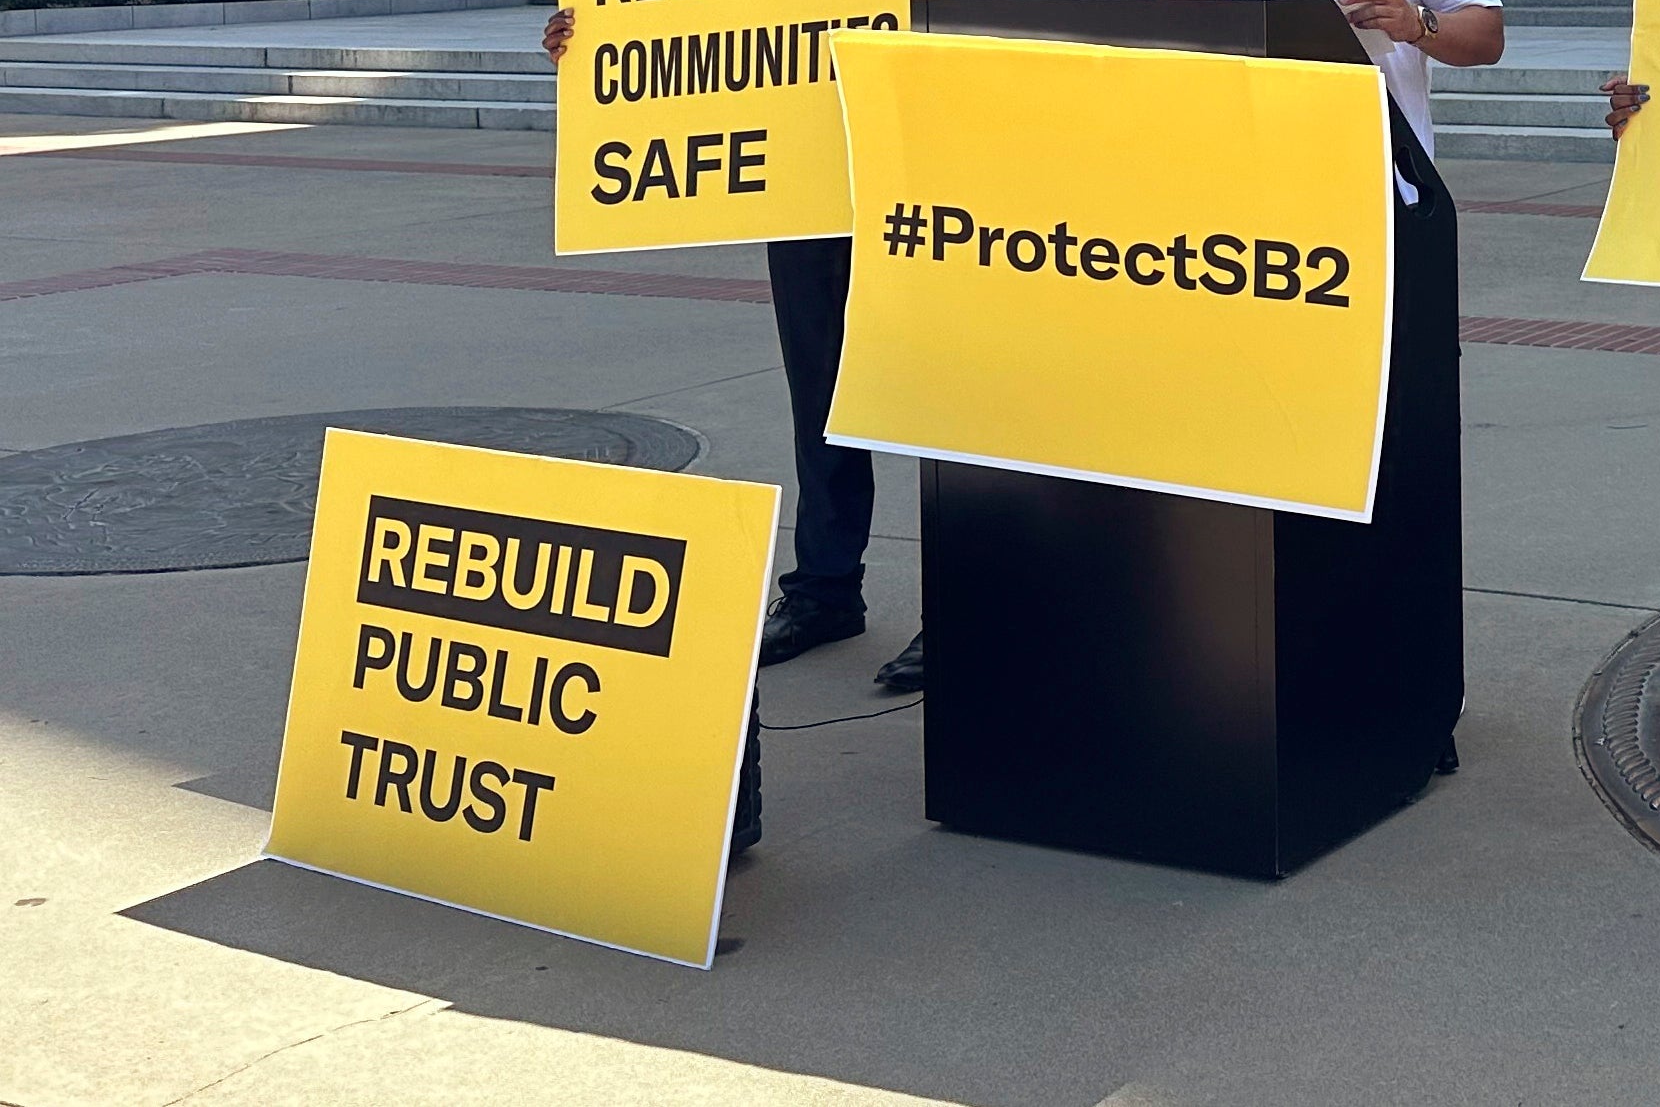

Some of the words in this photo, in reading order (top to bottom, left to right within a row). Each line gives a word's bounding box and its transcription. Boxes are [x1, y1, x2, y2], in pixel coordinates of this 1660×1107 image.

[594, 12, 899, 105] COMMUNIT
[590, 129, 768, 205] SAFE
[883, 202, 1350, 308] #ProtectSB2
[366, 516, 671, 629] REBUILD
[352, 623, 601, 735] PUBLIC
[340, 730, 556, 842] TRUST
